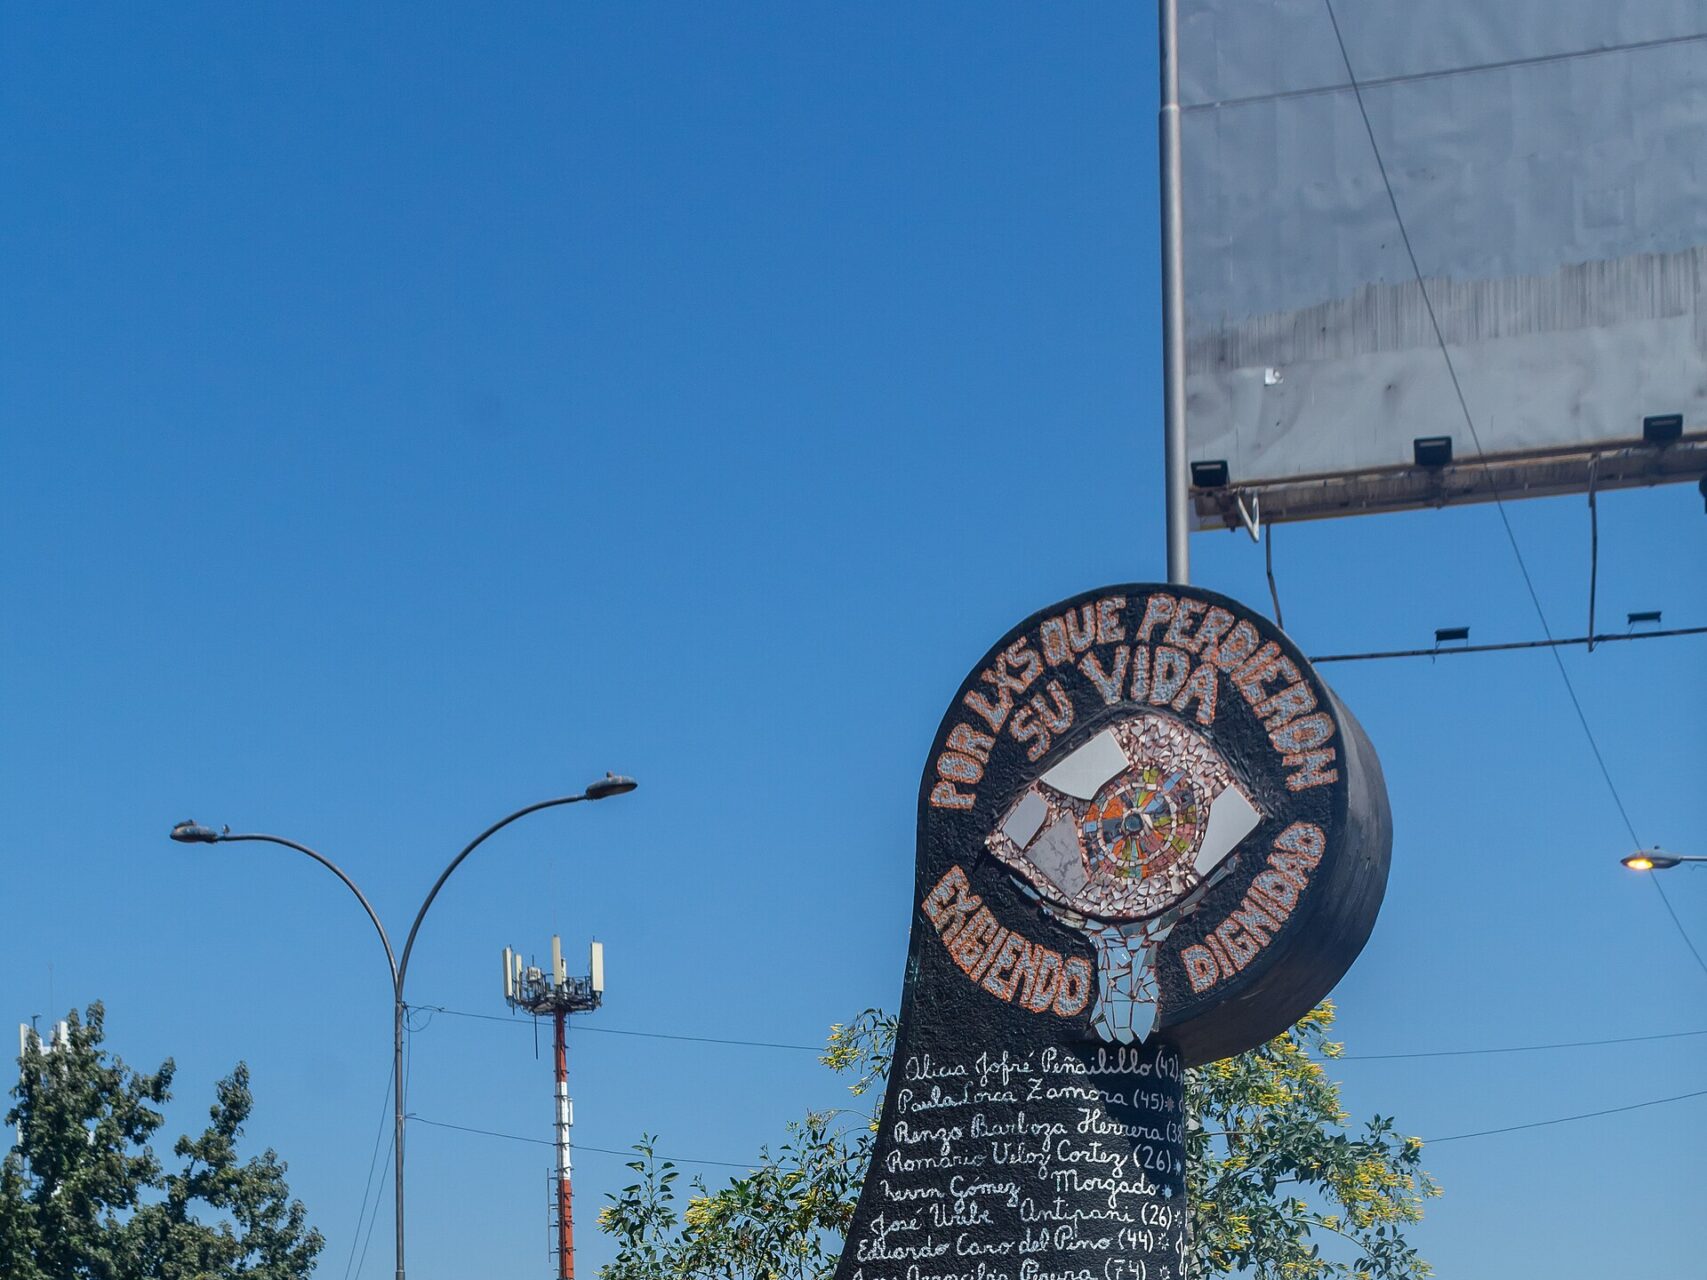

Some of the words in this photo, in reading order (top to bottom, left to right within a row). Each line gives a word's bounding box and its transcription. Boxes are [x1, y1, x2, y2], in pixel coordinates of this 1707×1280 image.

[930, 722, 997, 813] POR
[964, 635, 1045, 734] LXS
[1039, 593, 1127, 667] QUE
[1136, 592, 1339, 793] PERDIERON
[1009, 680, 1074, 762] SU
[1078, 645, 1219, 725] VIDA
[1180, 821, 1326, 994] DIGNIDAD
[921, 864, 1093, 1017] EXIGIENDO
[1042, 1046, 1153, 1076] Peñailillo
[1026, 1077, 1127, 1106] Zamora
[1133, 1088, 1164, 1112] (45)
[894, 1119, 964, 1156] Renzo
[971, 1111, 1068, 1153] Barboza
[1077, 1108, 1165, 1142] Herrera
[1165, 1121, 1184, 1145] (38
[1057, 1139, 1130, 1178] Cortez
[1133, 1143, 1172, 1175] (26)
[950, 1175, 1021, 1214] Gómez
[1050, 1168, 1158, 1207] Morgado
[1141, 1201, 1172, 1229] (26)
[956, 1233, 1012, 1256] Caro
[1019, 1227, 1048, 1255] del
[1054, 1224, 1113, 1251] Pino
[1119, 1227, 1154, 1254] (44)
